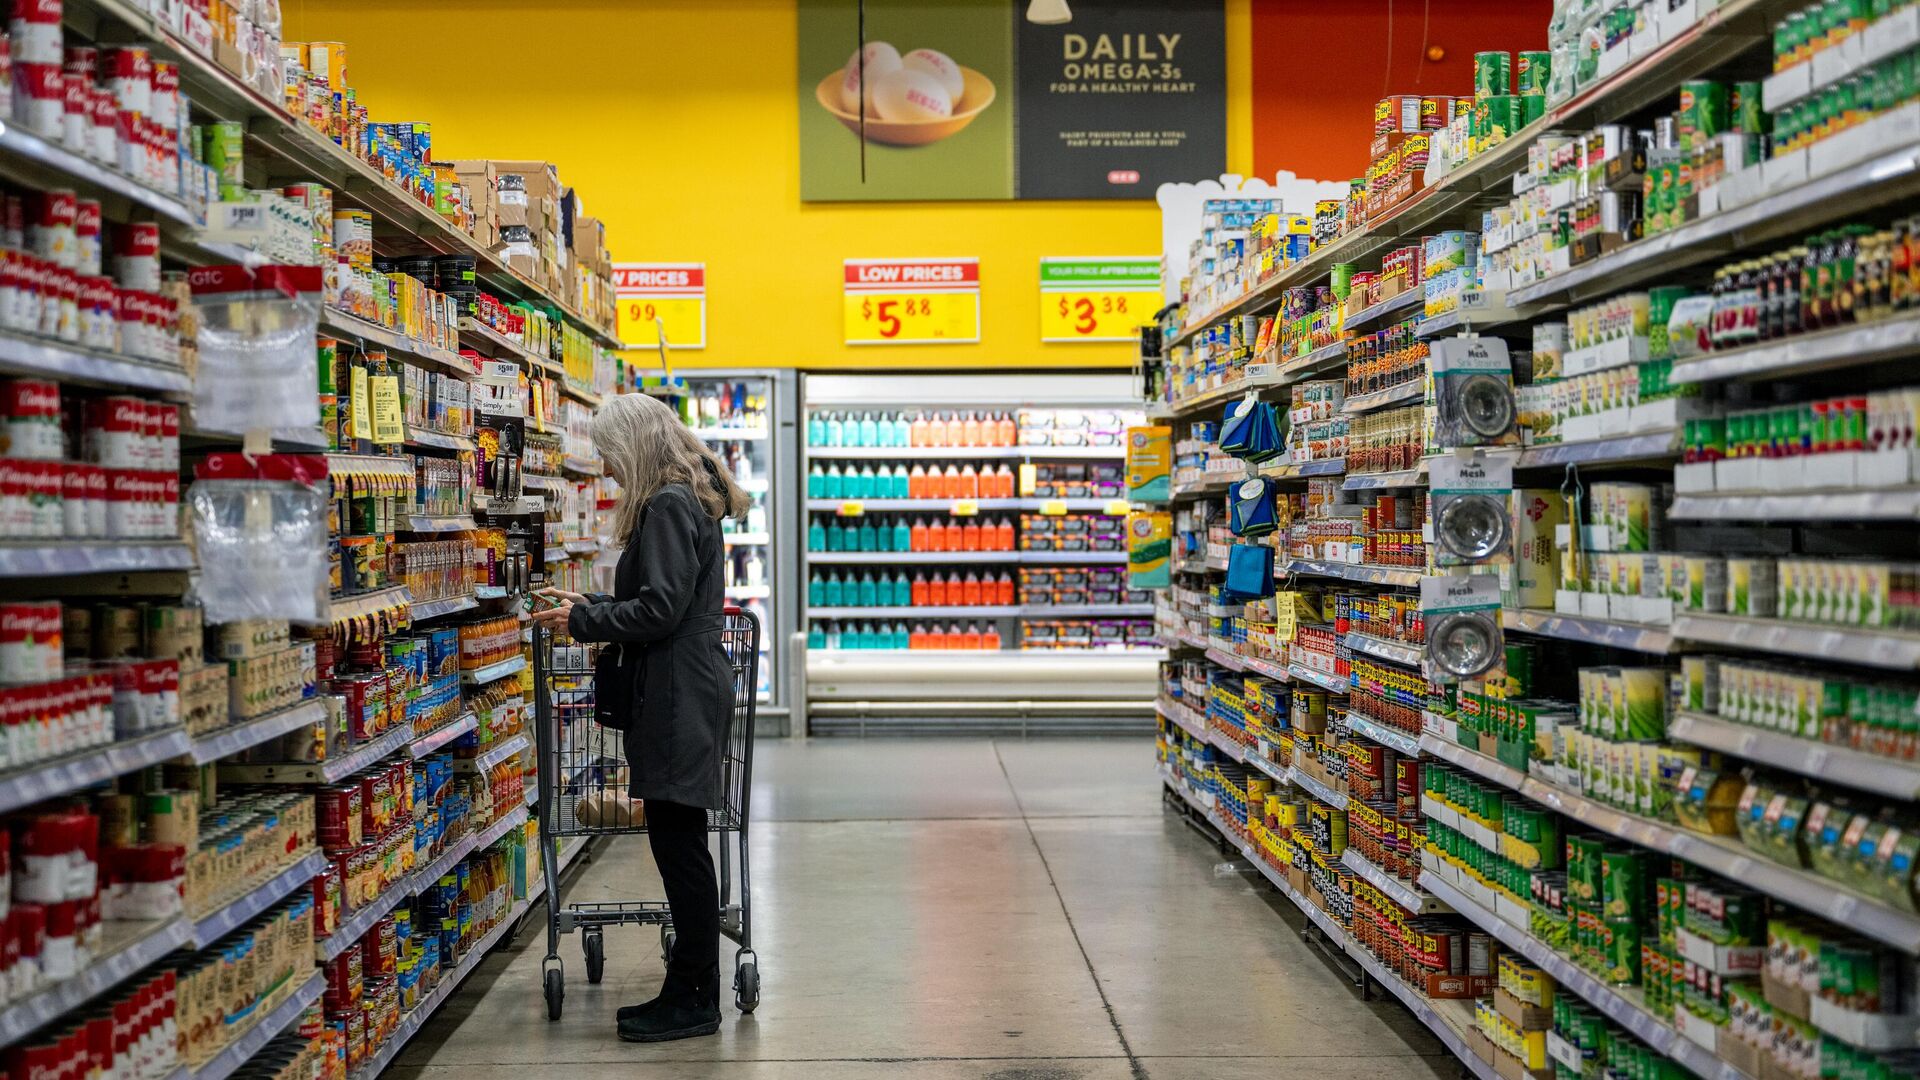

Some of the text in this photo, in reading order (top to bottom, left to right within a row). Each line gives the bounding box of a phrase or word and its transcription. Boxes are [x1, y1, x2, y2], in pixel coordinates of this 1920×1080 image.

[1064, 34, 1181, 60] DAILY
[1064, 63, 1181, 80] OMEGA-3s
[1050, 83, 1196, 93] FOR A HEALTHY HEART
[1060, 131, 1186, 139] DAIRY PRODUCTS ARE A VITAL
[1067, 139, 1088, 147] PART
[1090, 139, 1101, 147] OF
[1112, 139, 1157, 147] BALANCED
[1159, 139, 1179, 147] DIET
[859, 266, 963, 282] LOW PRICES
[1075, 267, 1097, 275] PRICE
[1100, 266, 1127, 275] AFTER
[628, 271, 689, 286] PRICES
[482, 401, 502, 411] simply
[1460, 469, 1486, 478] Mesh
[1448, 586, 1473, 596] Mesh
[1440, 982, 1463, 991] BUSH'S
